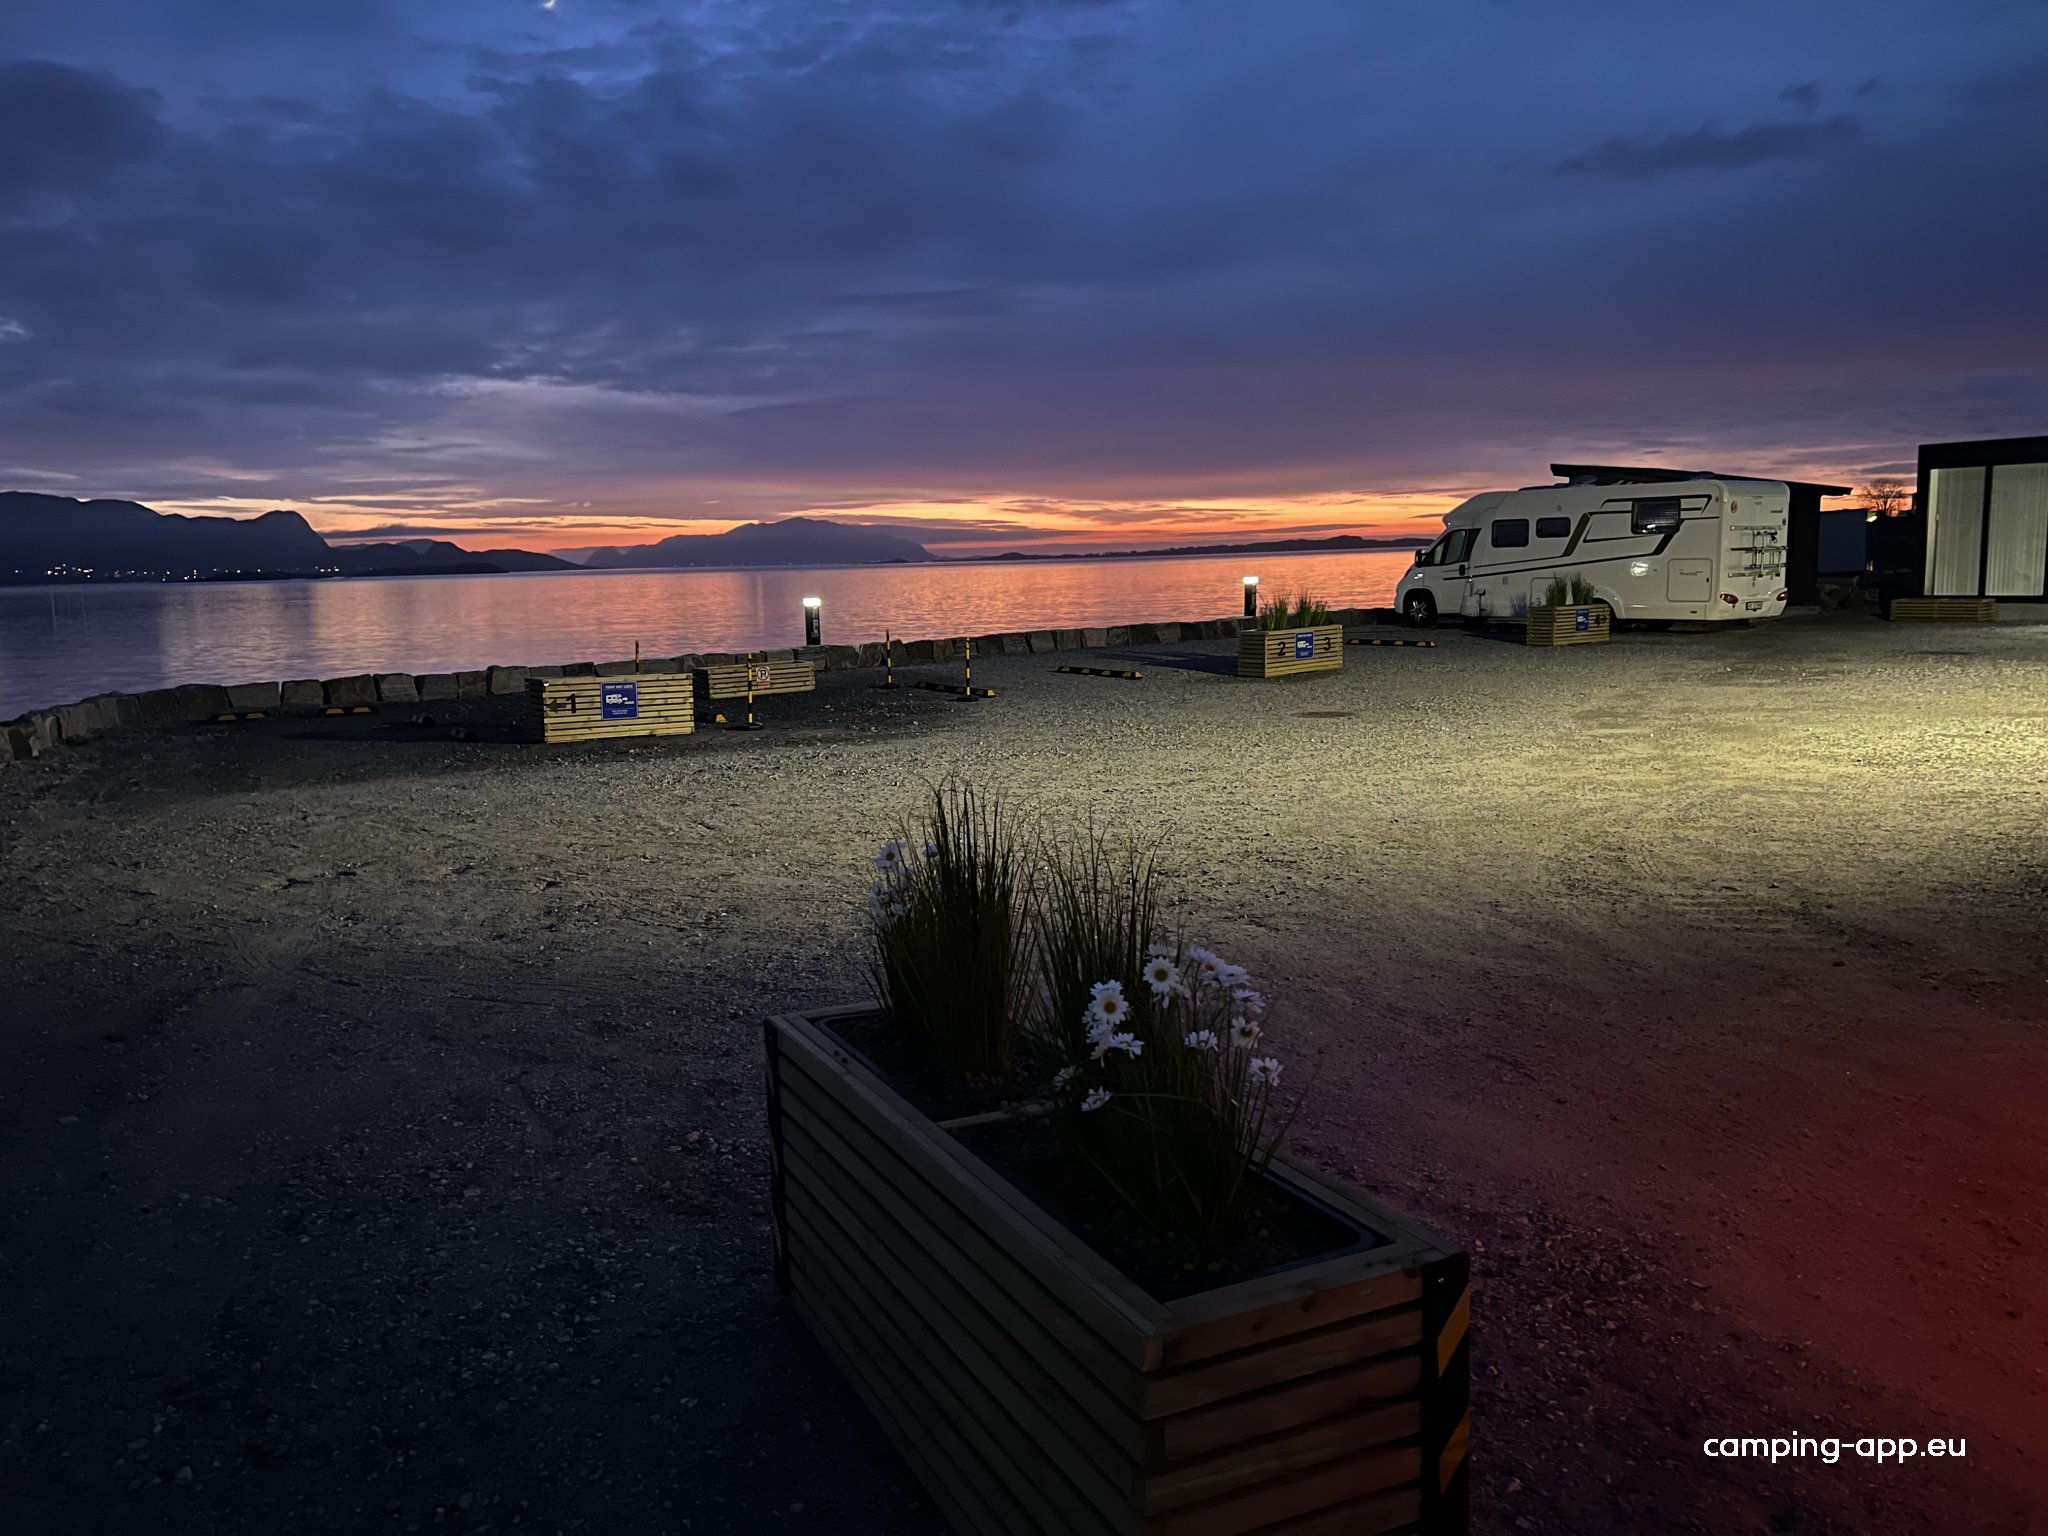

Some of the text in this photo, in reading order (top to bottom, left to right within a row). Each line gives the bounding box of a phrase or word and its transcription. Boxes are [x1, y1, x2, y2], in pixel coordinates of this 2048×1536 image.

[1278, 641, 1286, 656] 2
[1323, 637, 1331, 651] 3
[566, 693, 576, 714] 1
